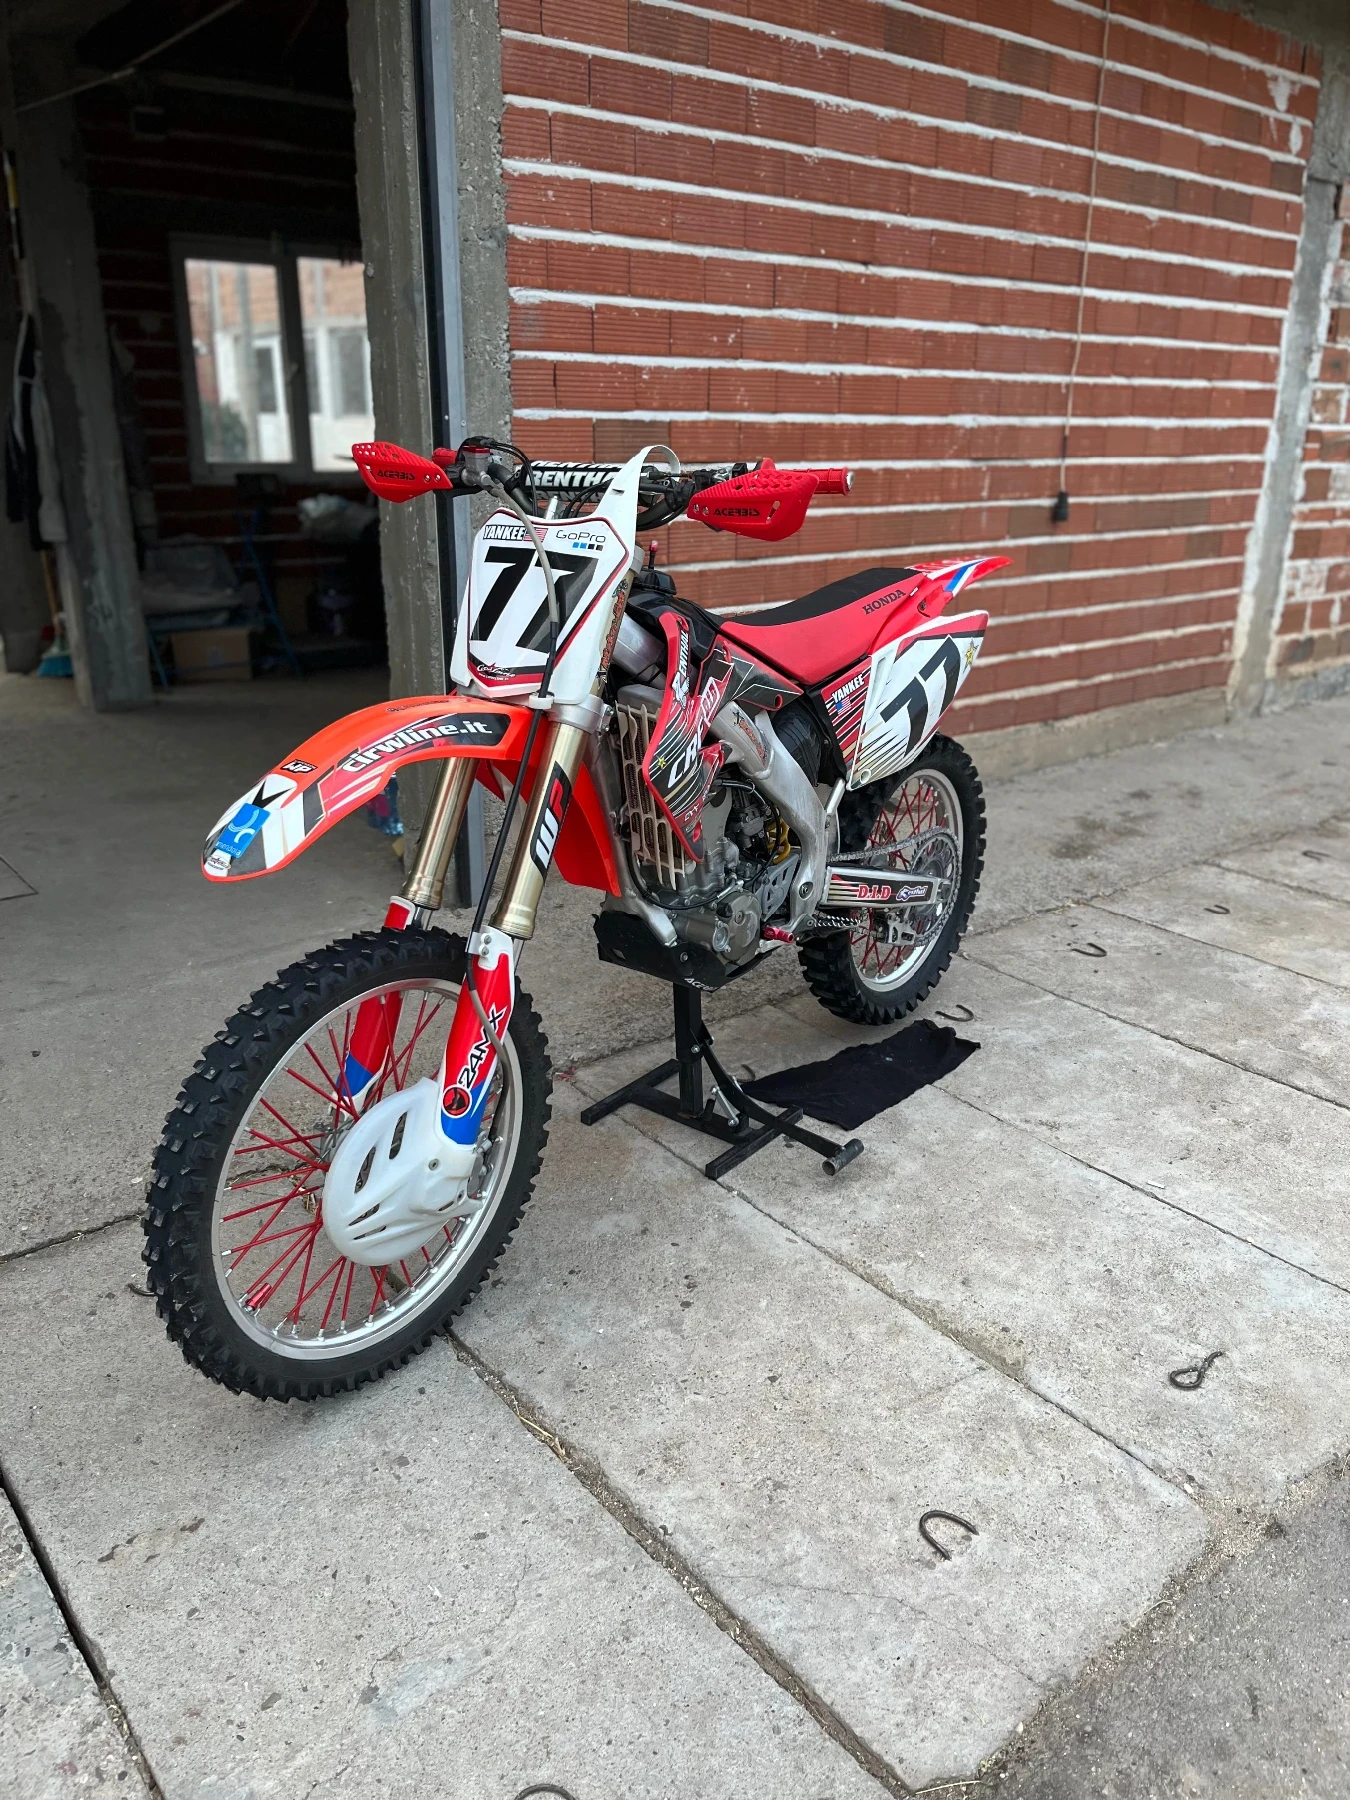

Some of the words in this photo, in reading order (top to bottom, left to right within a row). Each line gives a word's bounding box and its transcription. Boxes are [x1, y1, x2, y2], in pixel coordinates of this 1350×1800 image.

[525, 470, 617, 488] RENTHA
[713, 507, 761, 517] ACERBIS
[483, 525, 525, 542] YANKEE
[555, 529, 607, 544] GoPro
[470, 546, 599, 655] 77
[861, 588, 906, 616] HONDA
[672, 630, 691, 709] RENTHAL
[831, 673, 865, 703] YANKEE
[880, 635, 961, 759] 77
[341, 720, 493, 773] cirwline.it
[667, 716, 705, 789] CRF
[857, 885, 892, 901] D.I.D
[458, 1005, 506, 1089] 24MX
